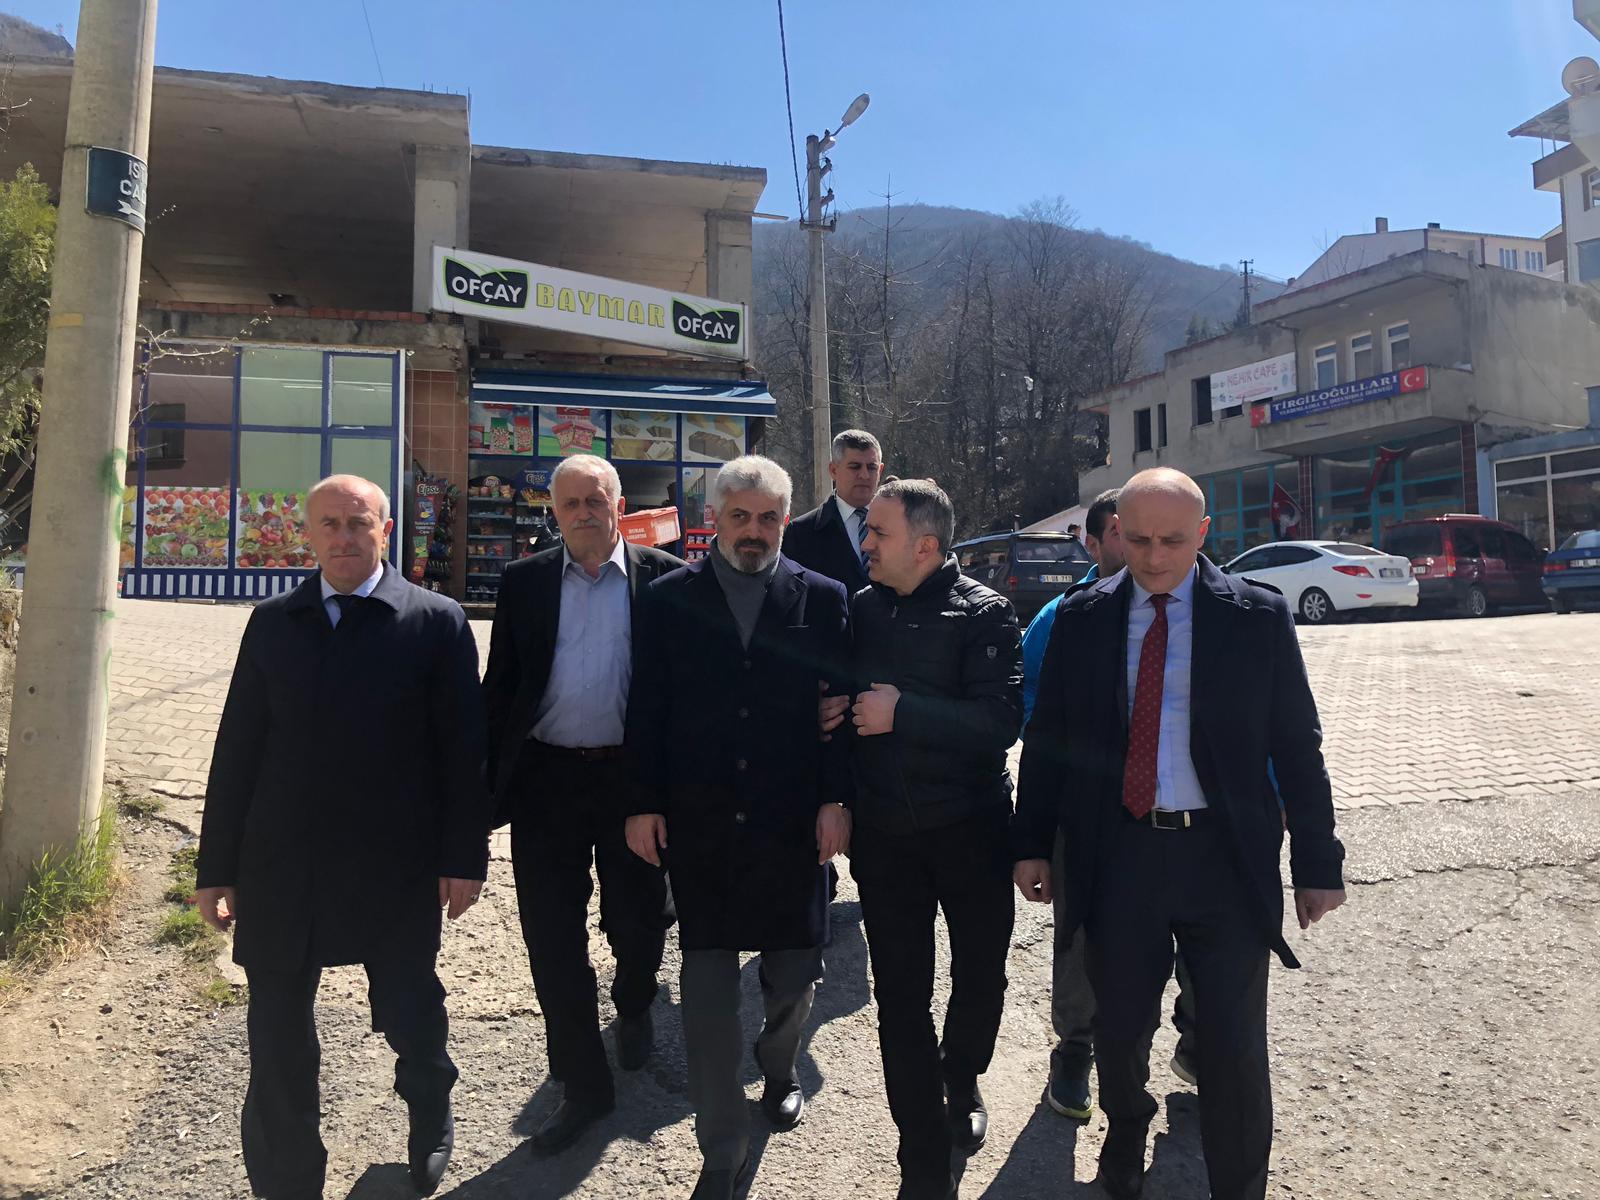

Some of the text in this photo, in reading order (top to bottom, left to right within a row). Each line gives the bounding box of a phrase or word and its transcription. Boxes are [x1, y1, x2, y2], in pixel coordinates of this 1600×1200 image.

[451, 275, 522, 303] OFÇAY
[536, 282, 665, 328] BAYMAR
[678, 315, 735, 340] OFÇAY
[1272, 375, 1398, 412] TİRGİLOĞULLARI
